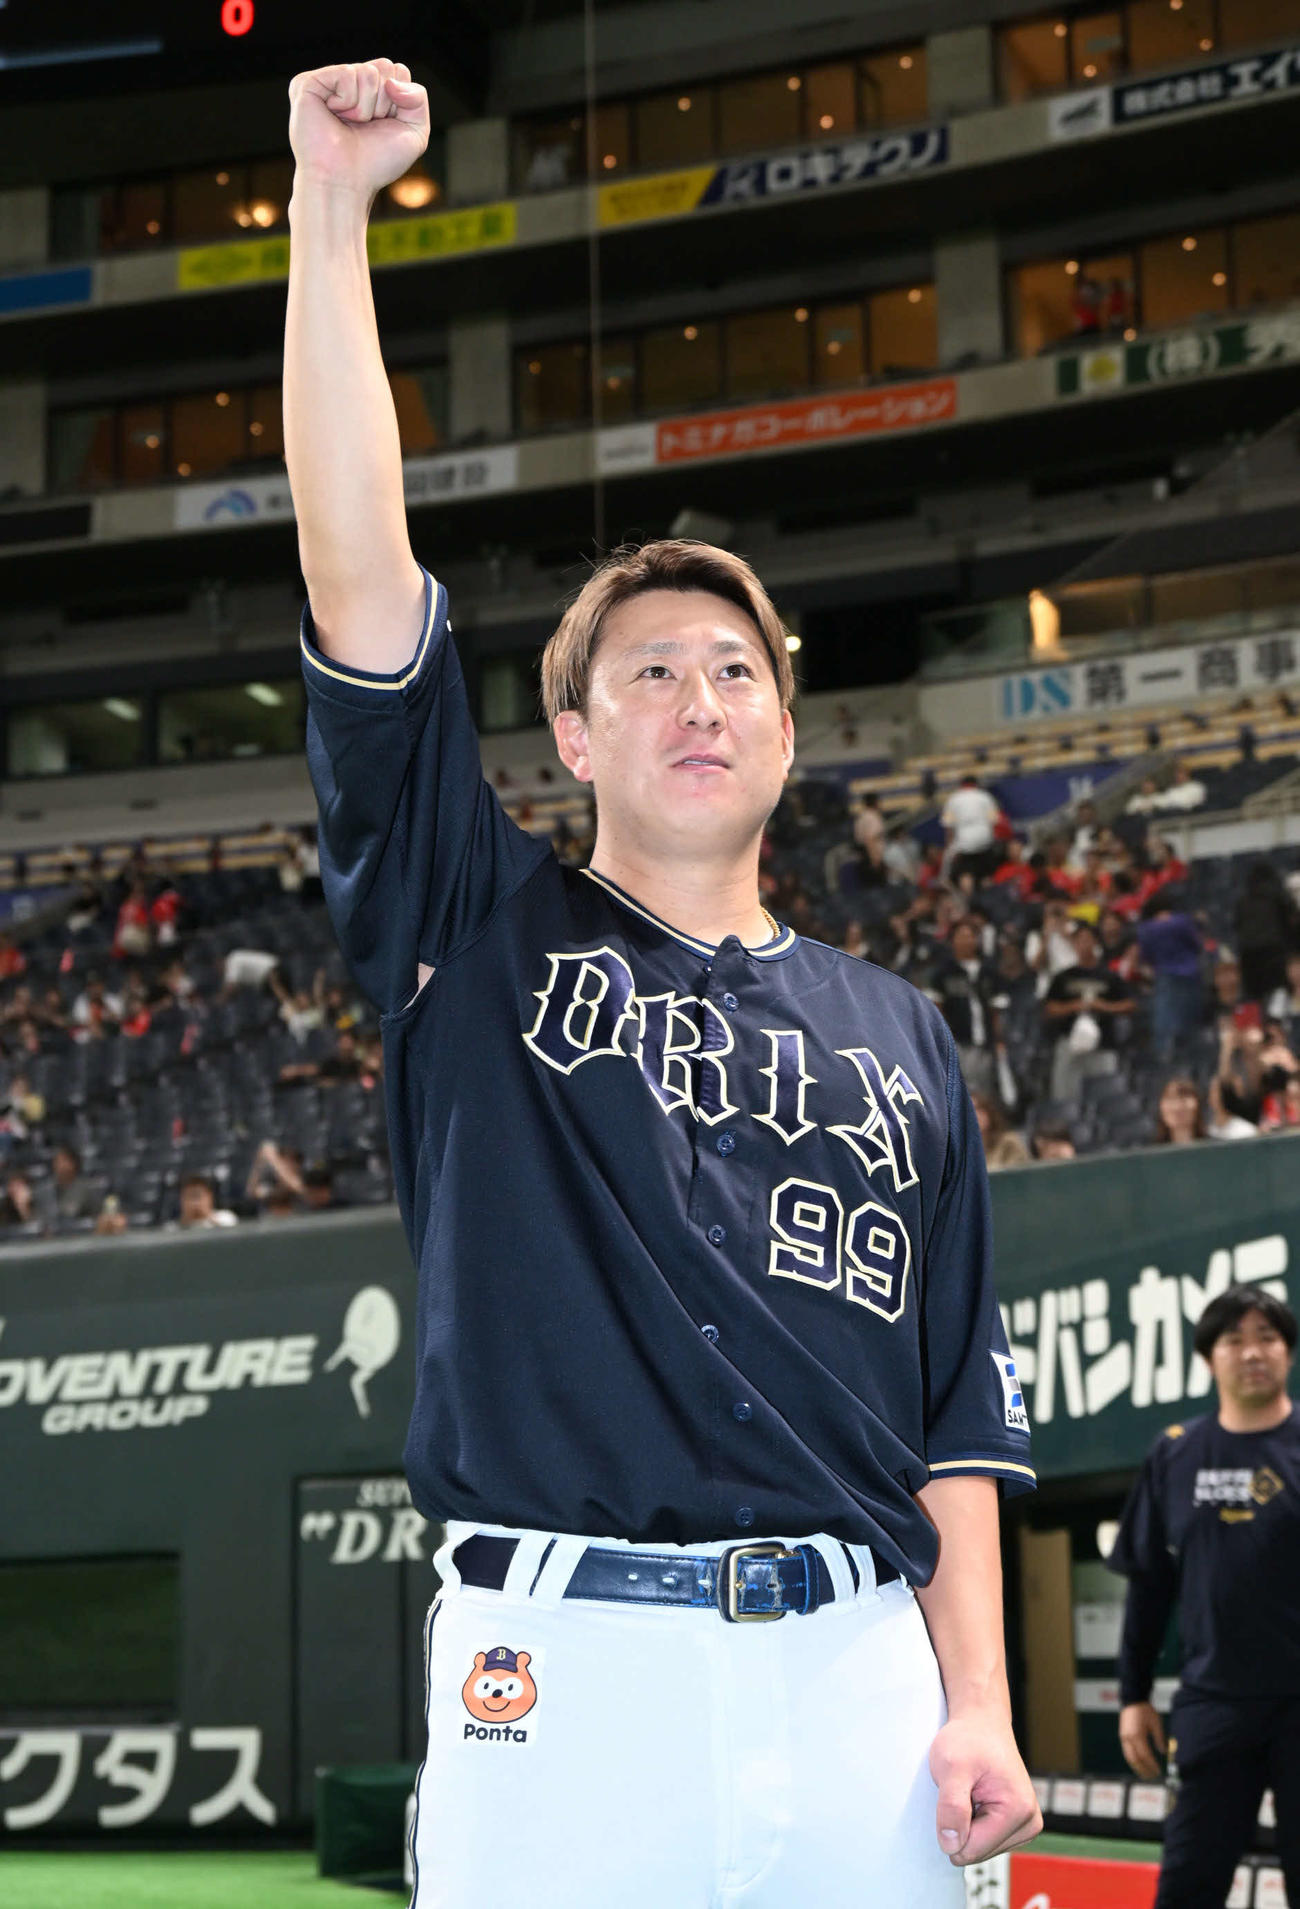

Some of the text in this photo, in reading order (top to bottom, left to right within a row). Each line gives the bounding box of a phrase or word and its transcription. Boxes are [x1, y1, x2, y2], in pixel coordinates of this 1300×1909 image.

[221, 0, 254, 37] 0
[1085, 638, 1298, 706] 第一商事
[522, 946, 924, 1192] ORIX
[768, 1177, 912, 1323] 99
[41, 1395, 211, 1436] GROUP
[496, 1648, 507, 1661] B
[463, 1723, 528, 1743] Ponta
[0, 1729, 277, 1830] クタス
